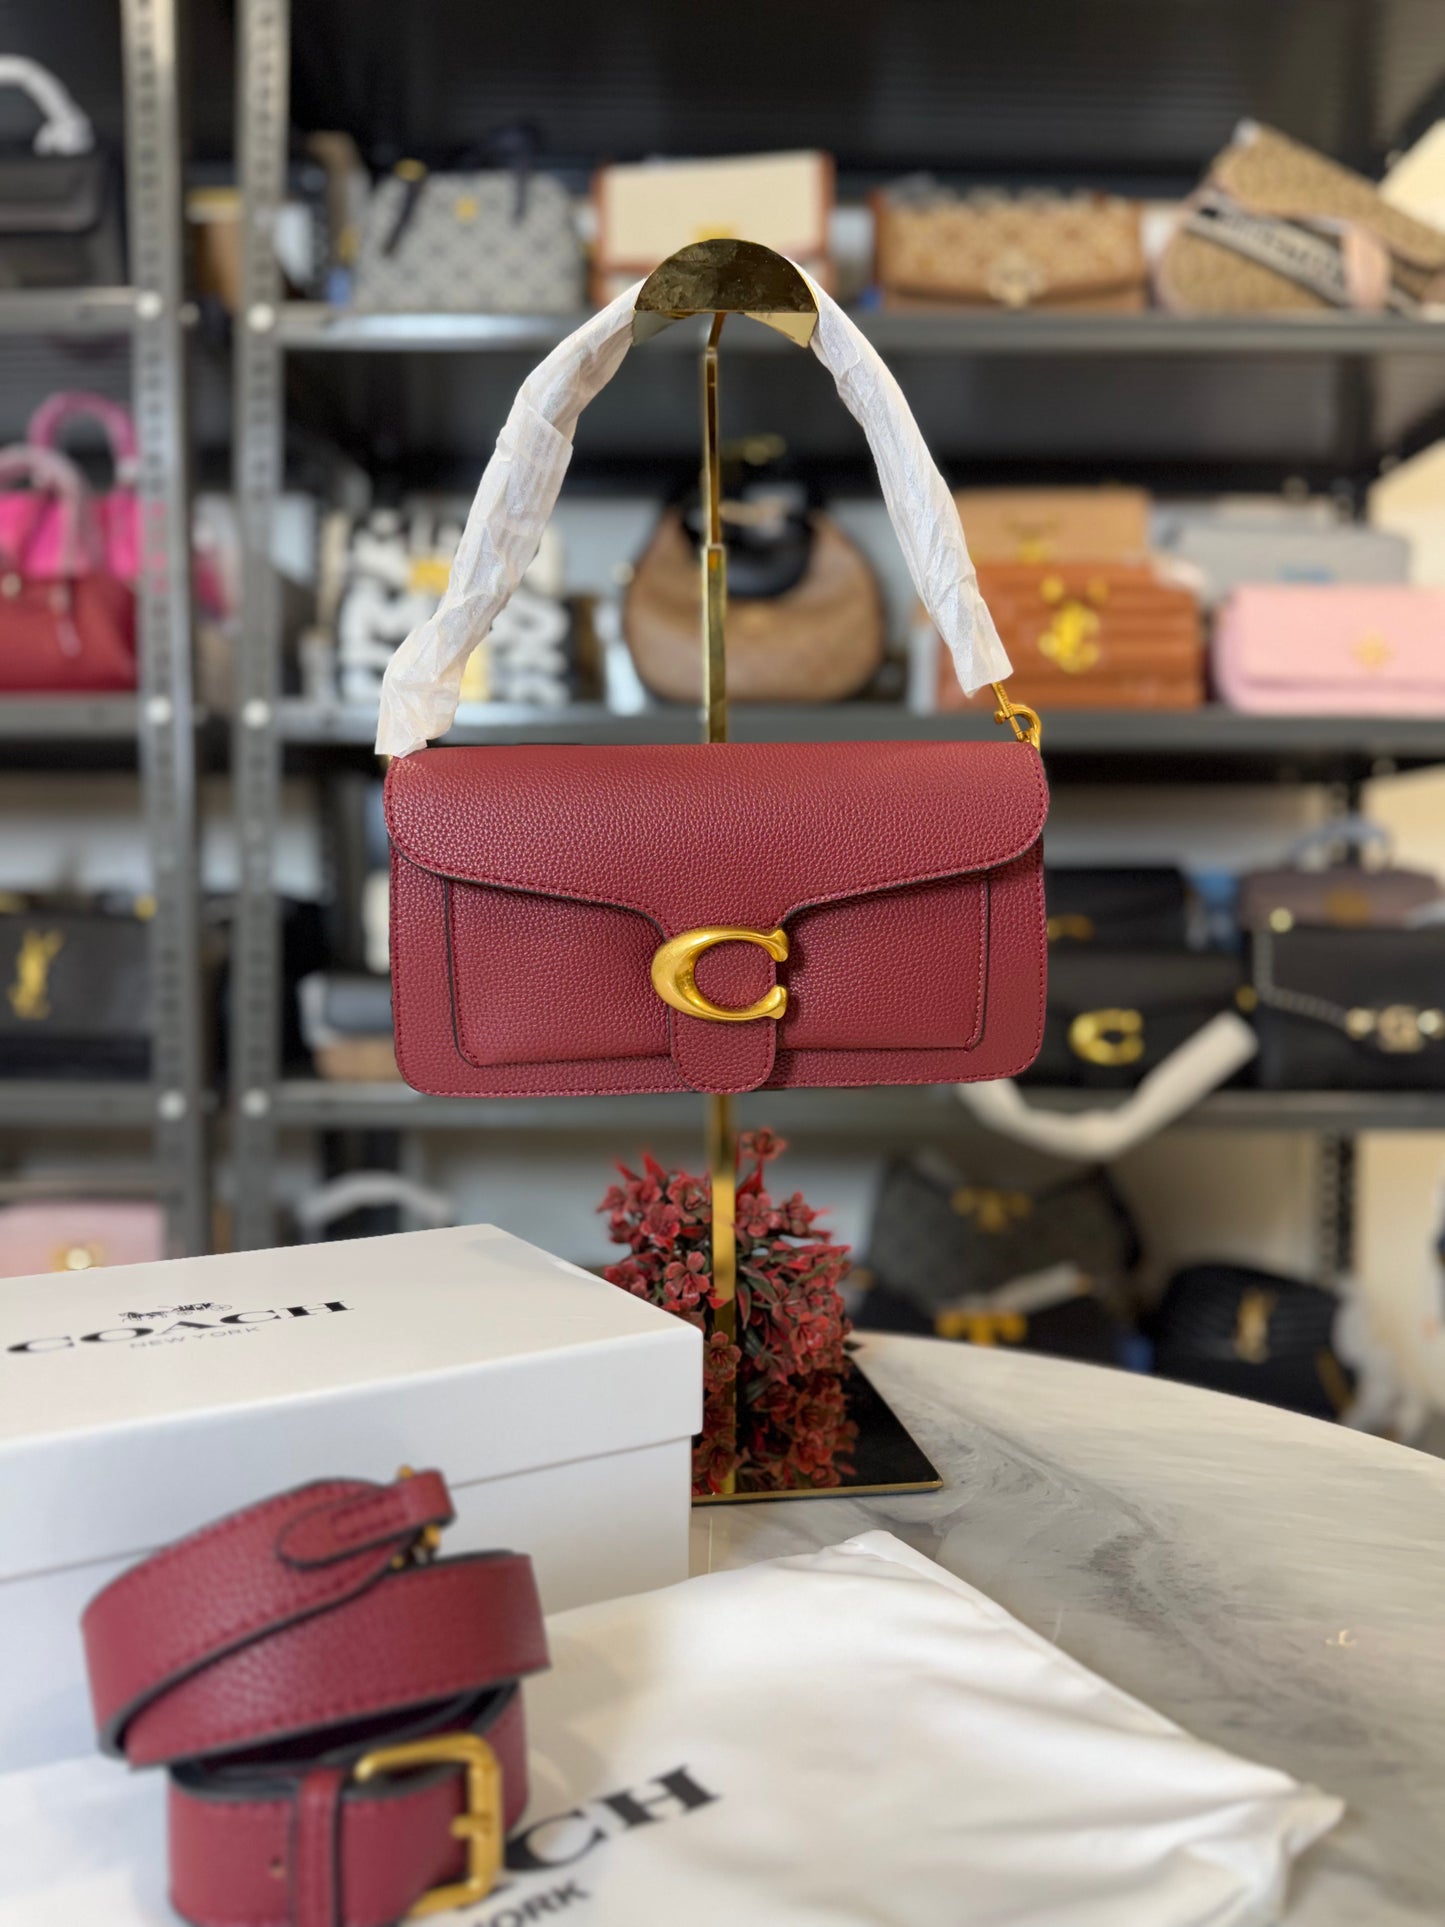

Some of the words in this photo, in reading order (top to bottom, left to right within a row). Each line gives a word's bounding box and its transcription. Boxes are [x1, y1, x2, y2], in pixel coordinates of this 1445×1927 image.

[7, 1300, 354, 1353] COACH
[129, 1335, 186, 1349] NEW
[191, 1326, 262, 1341] YORK
[474, 1880, 590, 1927] ORK
